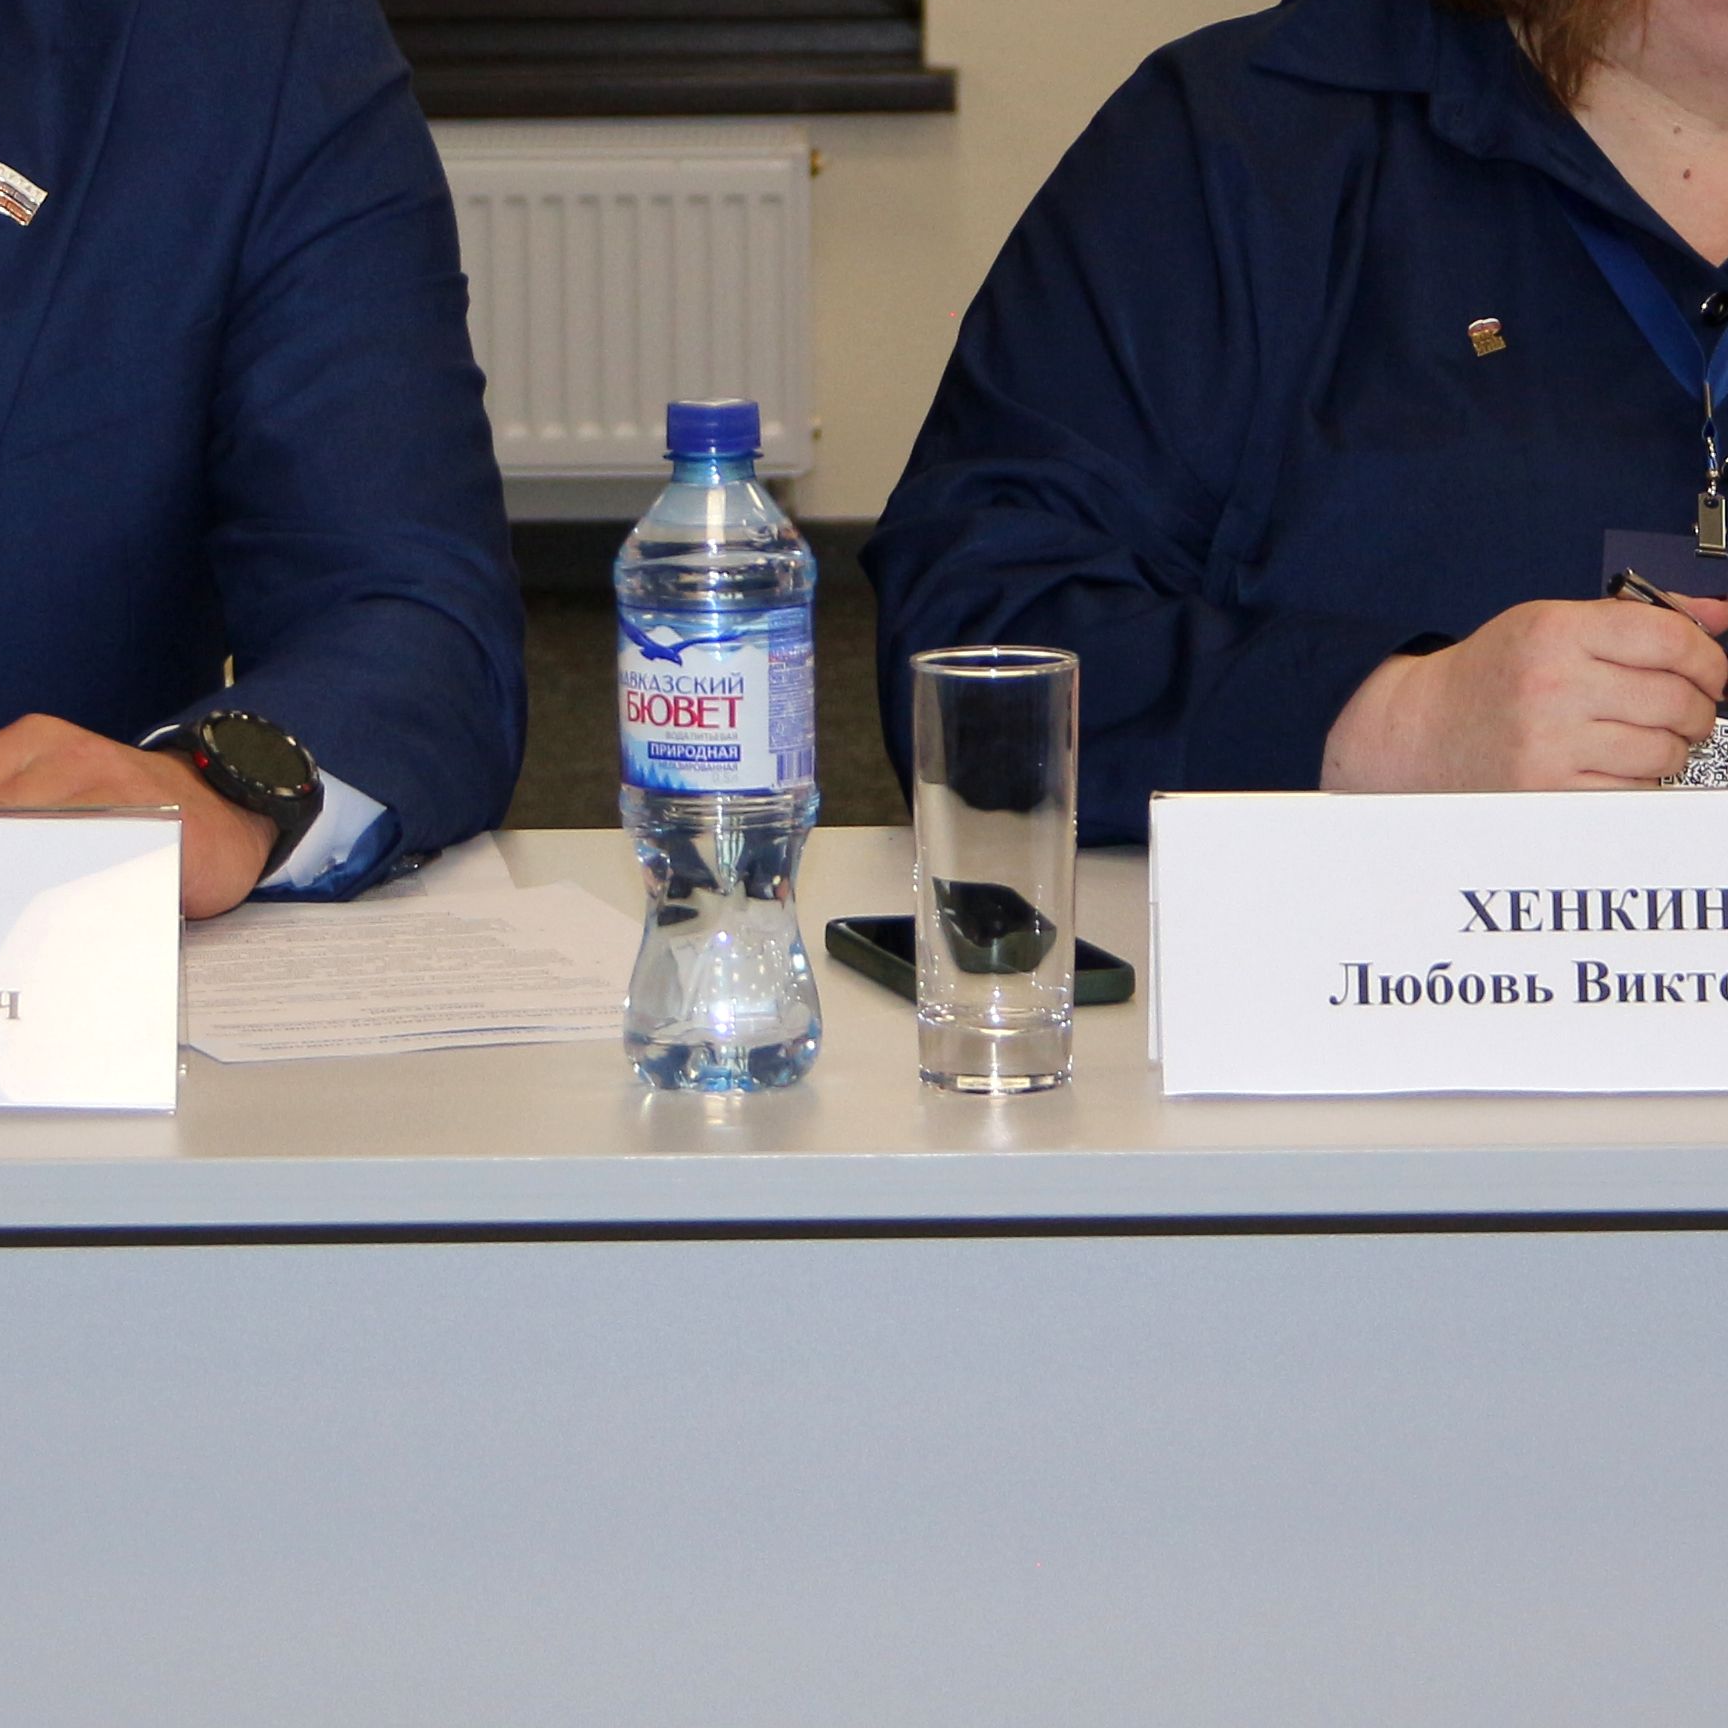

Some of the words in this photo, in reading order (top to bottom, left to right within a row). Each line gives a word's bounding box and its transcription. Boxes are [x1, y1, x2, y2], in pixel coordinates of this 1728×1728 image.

[626, 690, 744, 729] БЮВЕТ
[650, 742, 739, 761] ПРИРОДНАЯ
[1328, 961, 1555, 1007] Любовь
